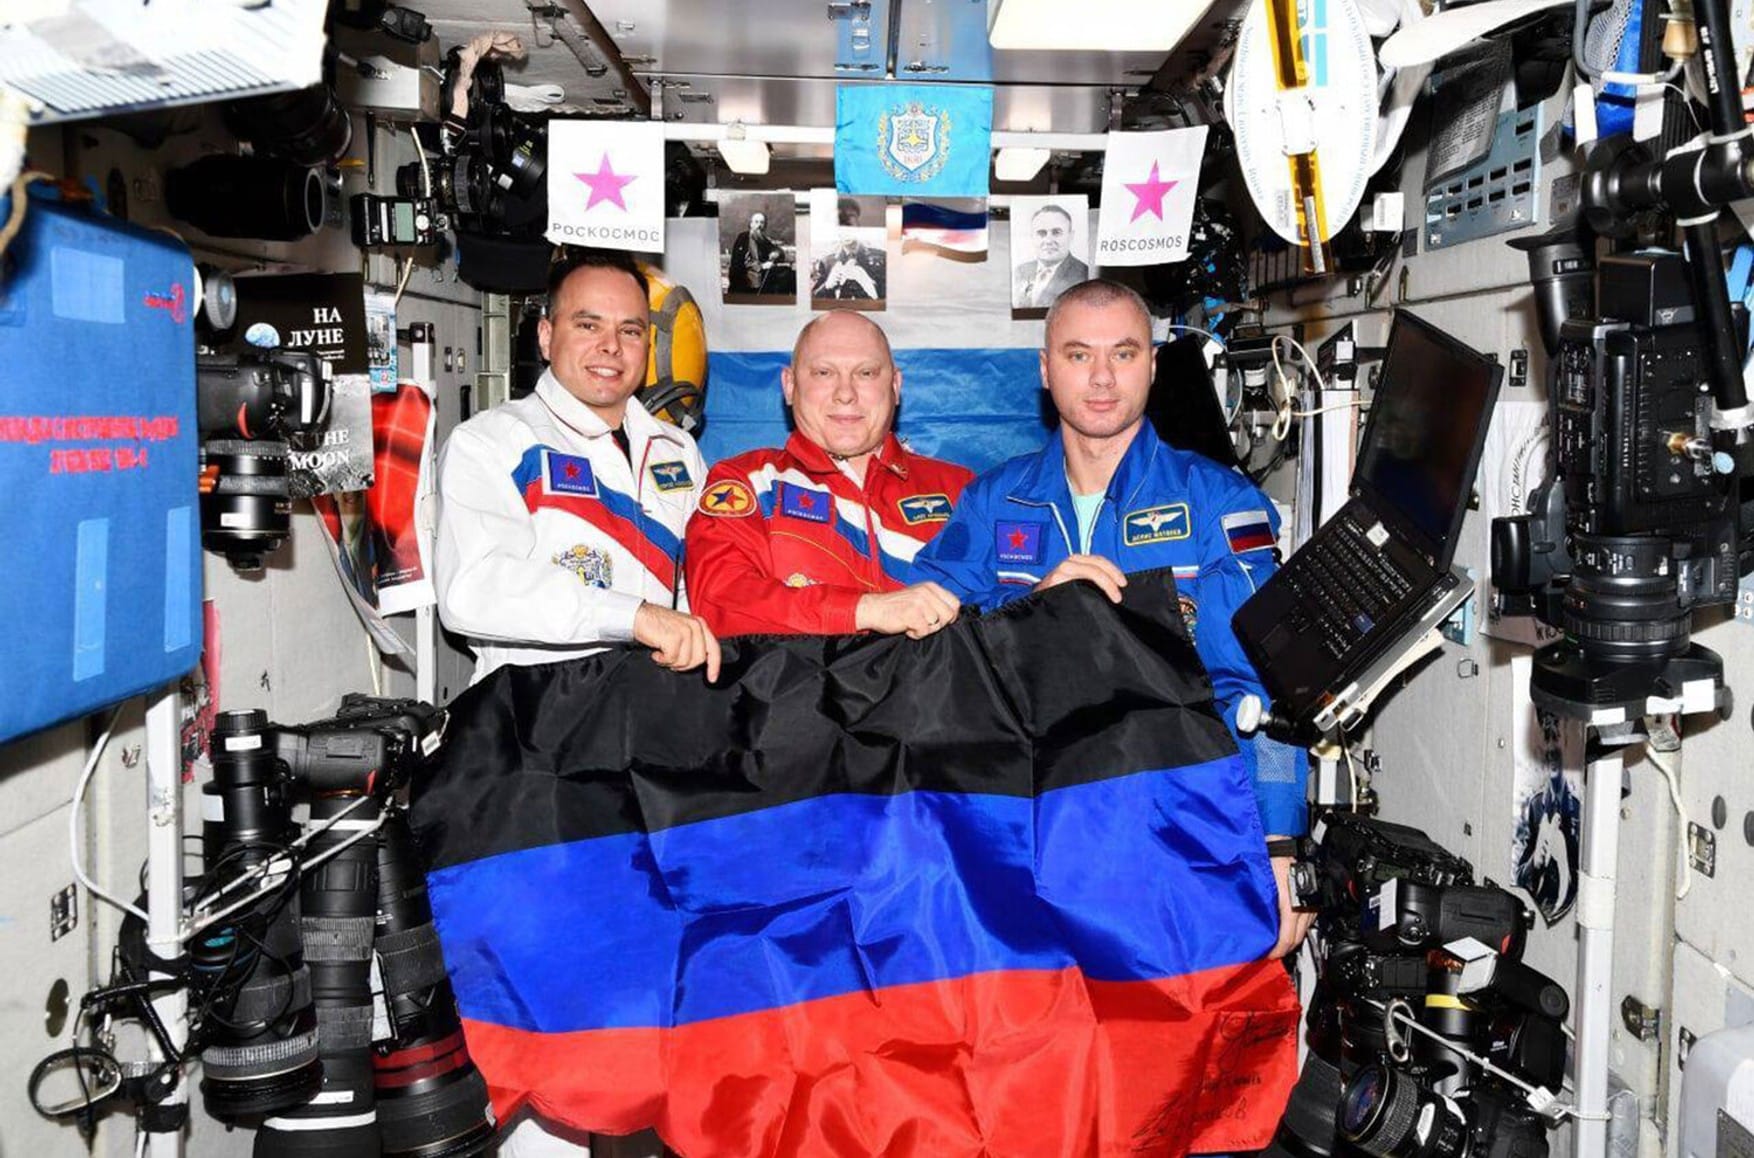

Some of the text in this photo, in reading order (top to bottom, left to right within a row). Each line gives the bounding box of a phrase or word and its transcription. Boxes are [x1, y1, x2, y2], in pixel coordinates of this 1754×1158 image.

[551, 222, 660, 242] РОСКОСМОС
[1100, 235, 1183, 252] ROSCOSMOS
[313, 306, 343, 324] НА
[287, 328, 344, 347] ЛУНЕ
[310, 429, 350, 447] THE
[288, 449, 350, 471] MOON
